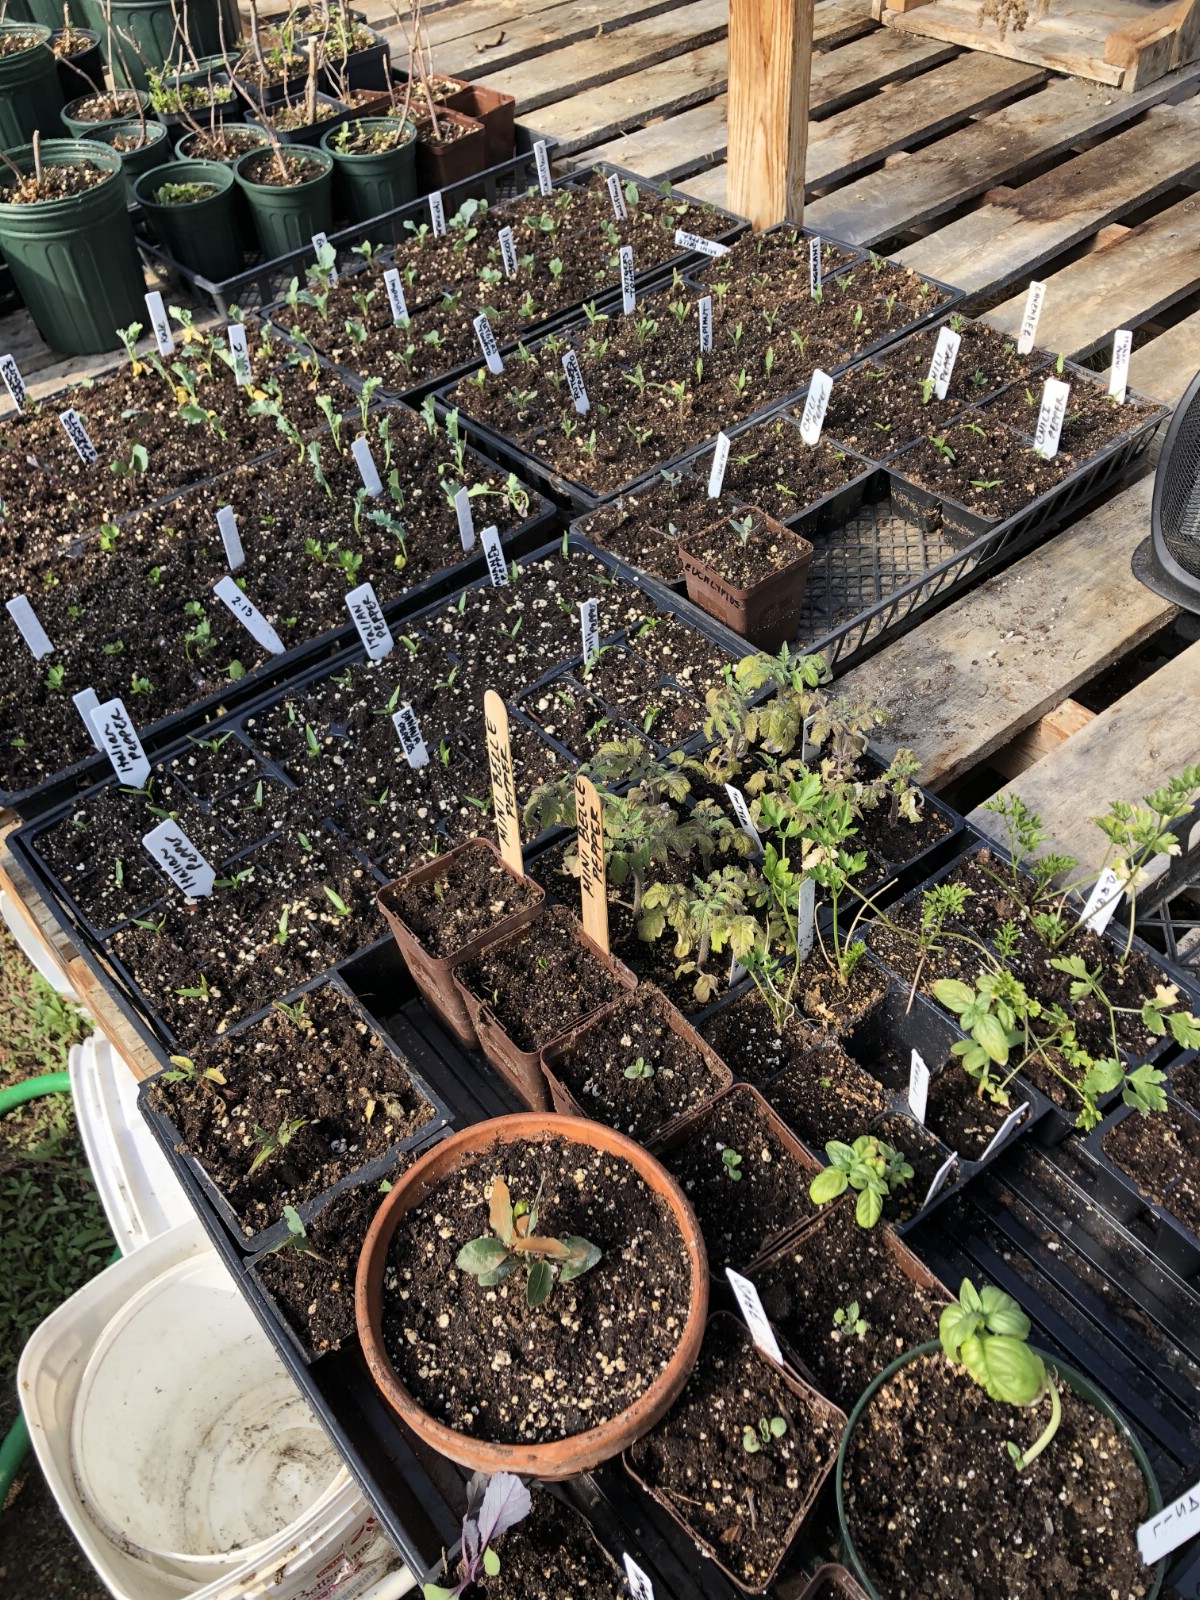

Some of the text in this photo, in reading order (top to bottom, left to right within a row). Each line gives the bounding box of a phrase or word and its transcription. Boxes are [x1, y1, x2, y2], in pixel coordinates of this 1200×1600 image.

[803, 394, 816, 432] CHILI
[1037, 405, 1051, 445] CHILI
[1048, 395, 1064, 439] PEPPER
[363, 595, 386, 639] PEPPER
[105, 723, 133, 773] Italian
[486, 716, 510, 848] MINI BELLE
[500, 744, 516, 820] PEPPER
[576, 780, 594, 899] MINI BELLE
[590, 806, 602, 885] PEPPER
[161, 848, 196, 890] Italian
